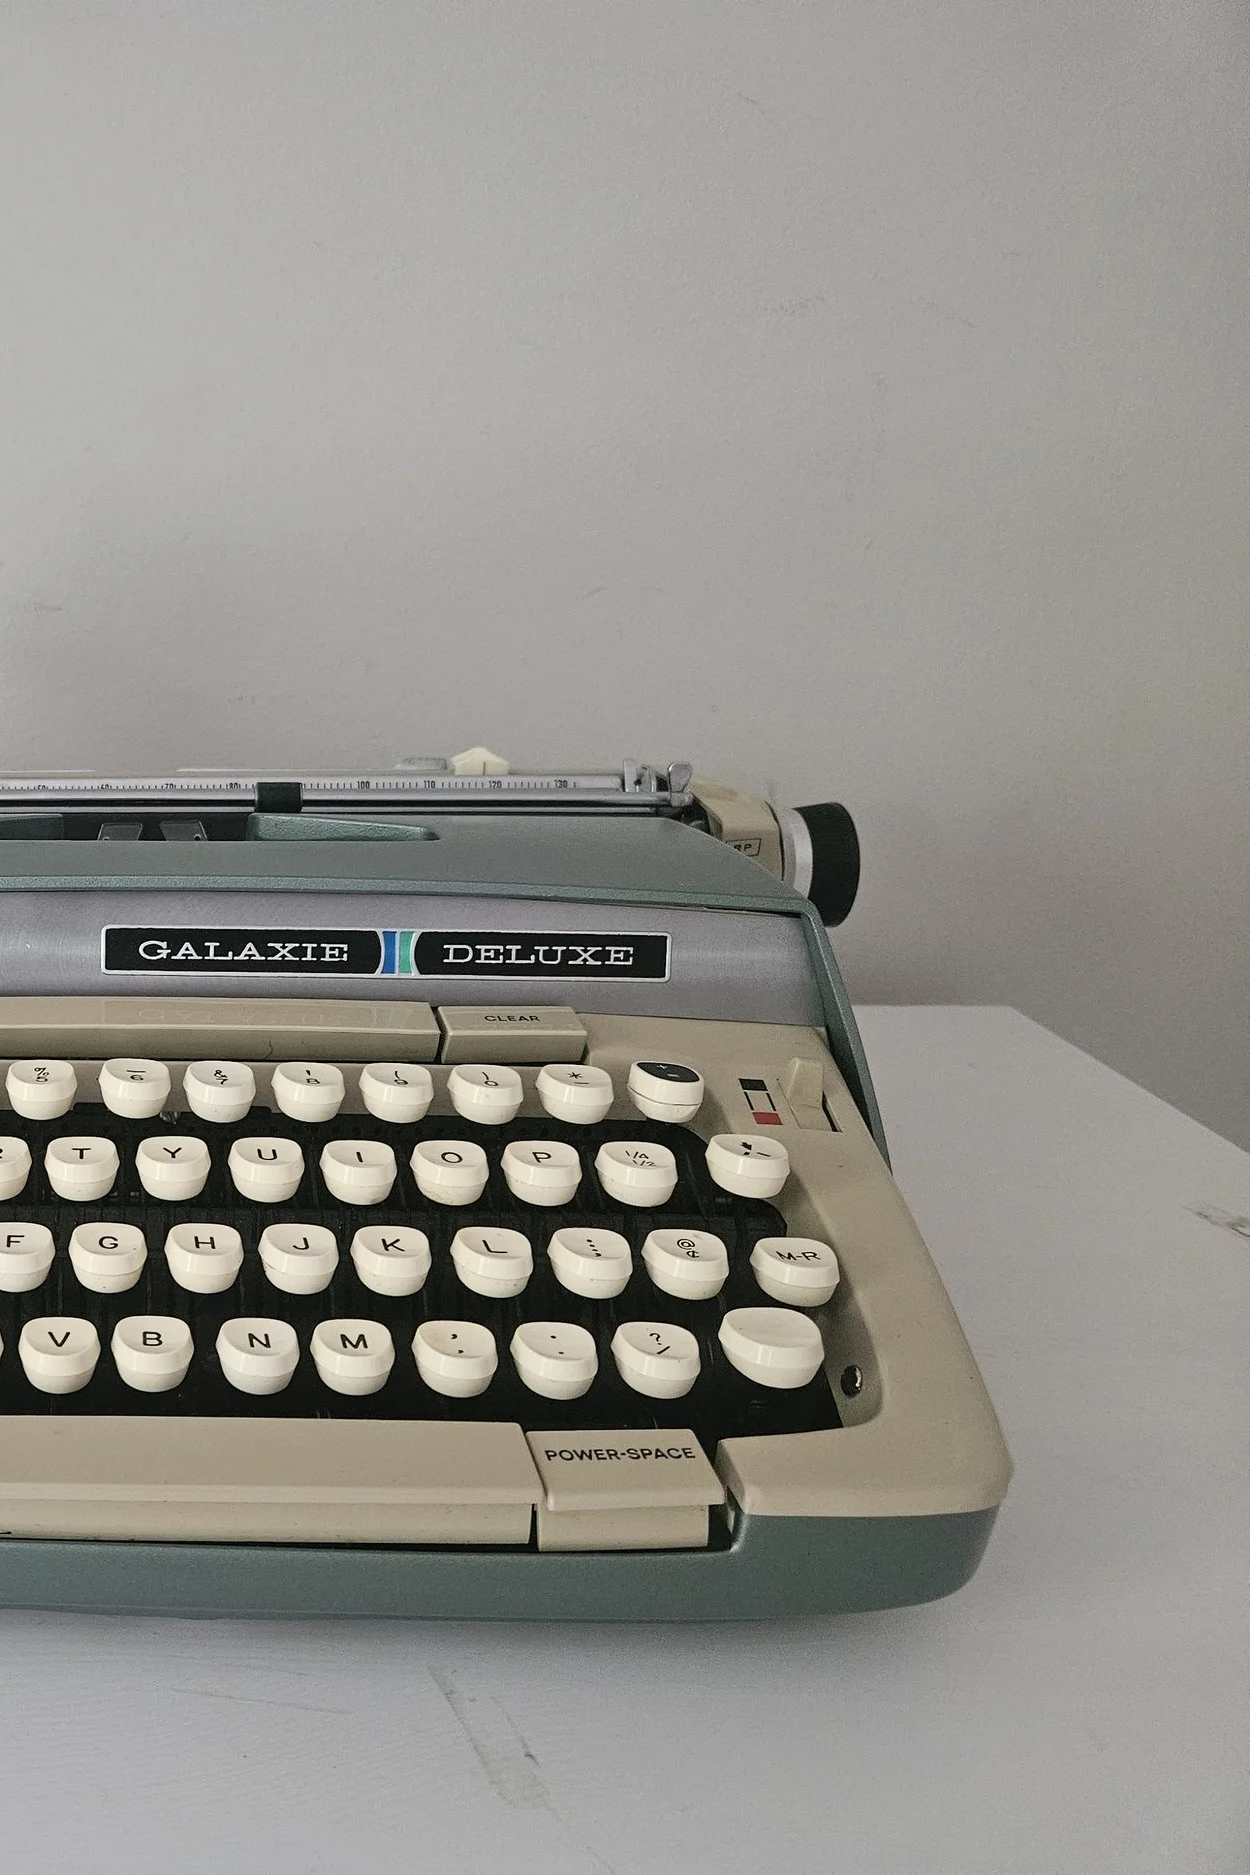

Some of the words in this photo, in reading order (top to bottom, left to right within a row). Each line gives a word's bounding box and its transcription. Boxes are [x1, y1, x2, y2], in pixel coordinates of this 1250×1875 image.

[357, 780, 370, 789] 100
[423, 780, 436, 789] 110
[488, 780, 502, 789] 120
[554, 779, 568, 789] 130
[139, 941, 347, 961] GALAXIE
[443, 945, 633, 965] DELUXE
[34, 1068, 49, 1076] %
[214, 1069, 228, 1078] &
[72, 1148, 91, 1159] T
[163, 1148, 182, 1158] Y
[257, 1149, 277, 1160] U
[356, 1152, 363, 1162] I
[441, 1152, 463, 1163] O
[532, 1152, 551, 1163] P
[7, 1235, 24, 1247] F
[99, 1236, 118, 1249] G
[194, 1236, 215, 1249] H
[293, 1238, 309, 1250] J
[382, 1239, 405, 1251] K
[482, 1240, 507, 1253] L
[677, 1239, 695, 1250] @
[48, 1332, 70, 1347] V
[143, 1332, 162, 1346] B
[248, 1333, 271, 1348] N
[340, 1334, 368, 1349] M
[545, 1448, 695, 1461] POWER-SPACE
